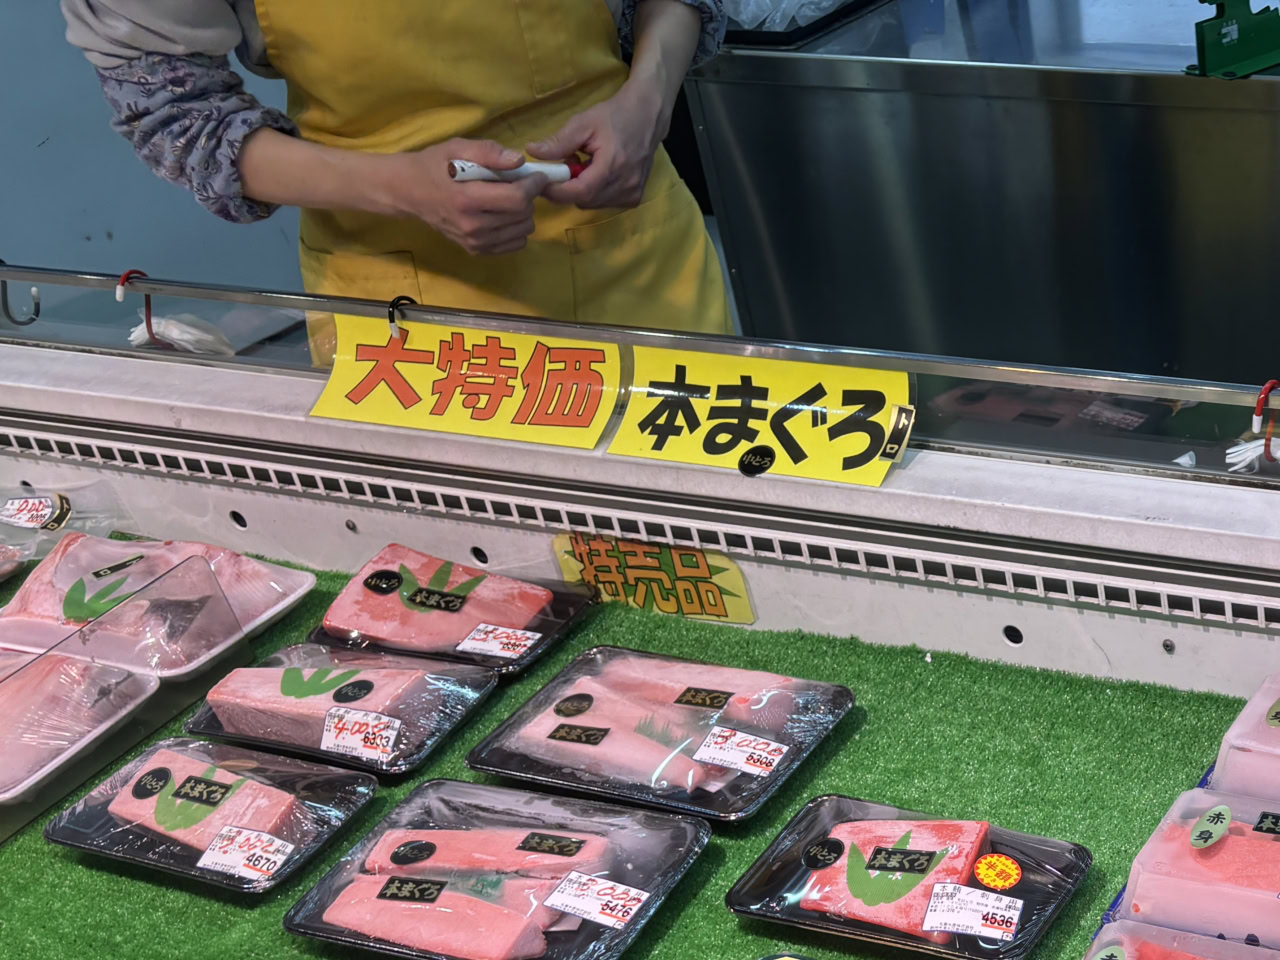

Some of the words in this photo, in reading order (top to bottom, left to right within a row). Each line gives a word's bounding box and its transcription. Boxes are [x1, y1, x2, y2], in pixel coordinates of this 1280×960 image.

[347, 327, 606, 429] 大特価
[637, 365, 887, 471] 本まぐろ
[886, 411, 909, 454] トロ
[570, 530, 728, 618] 特売品
[680, 690, 728, 707] 本まぐろ
[552, 725, 605, 743] 本まぐろ
[746, 751, 775, 768] 5308
[179, 780, 227, 802] 本まぐろ
[1193, 811, 1226, 844] 赤身
[525, 836, 578, 854] 本まぐろ
[809, 844, 838, 864] 中とろ
[246, 852, 277, 872] 4670
[871, 851, 930, 872] 本まぐろ
[984, 860, 1014, 883] 半額
[382, 880, 442, 901] 本まぐろ
[601, 899, 633, 917] 5476
[982, 911, 1014, 928] 4536
